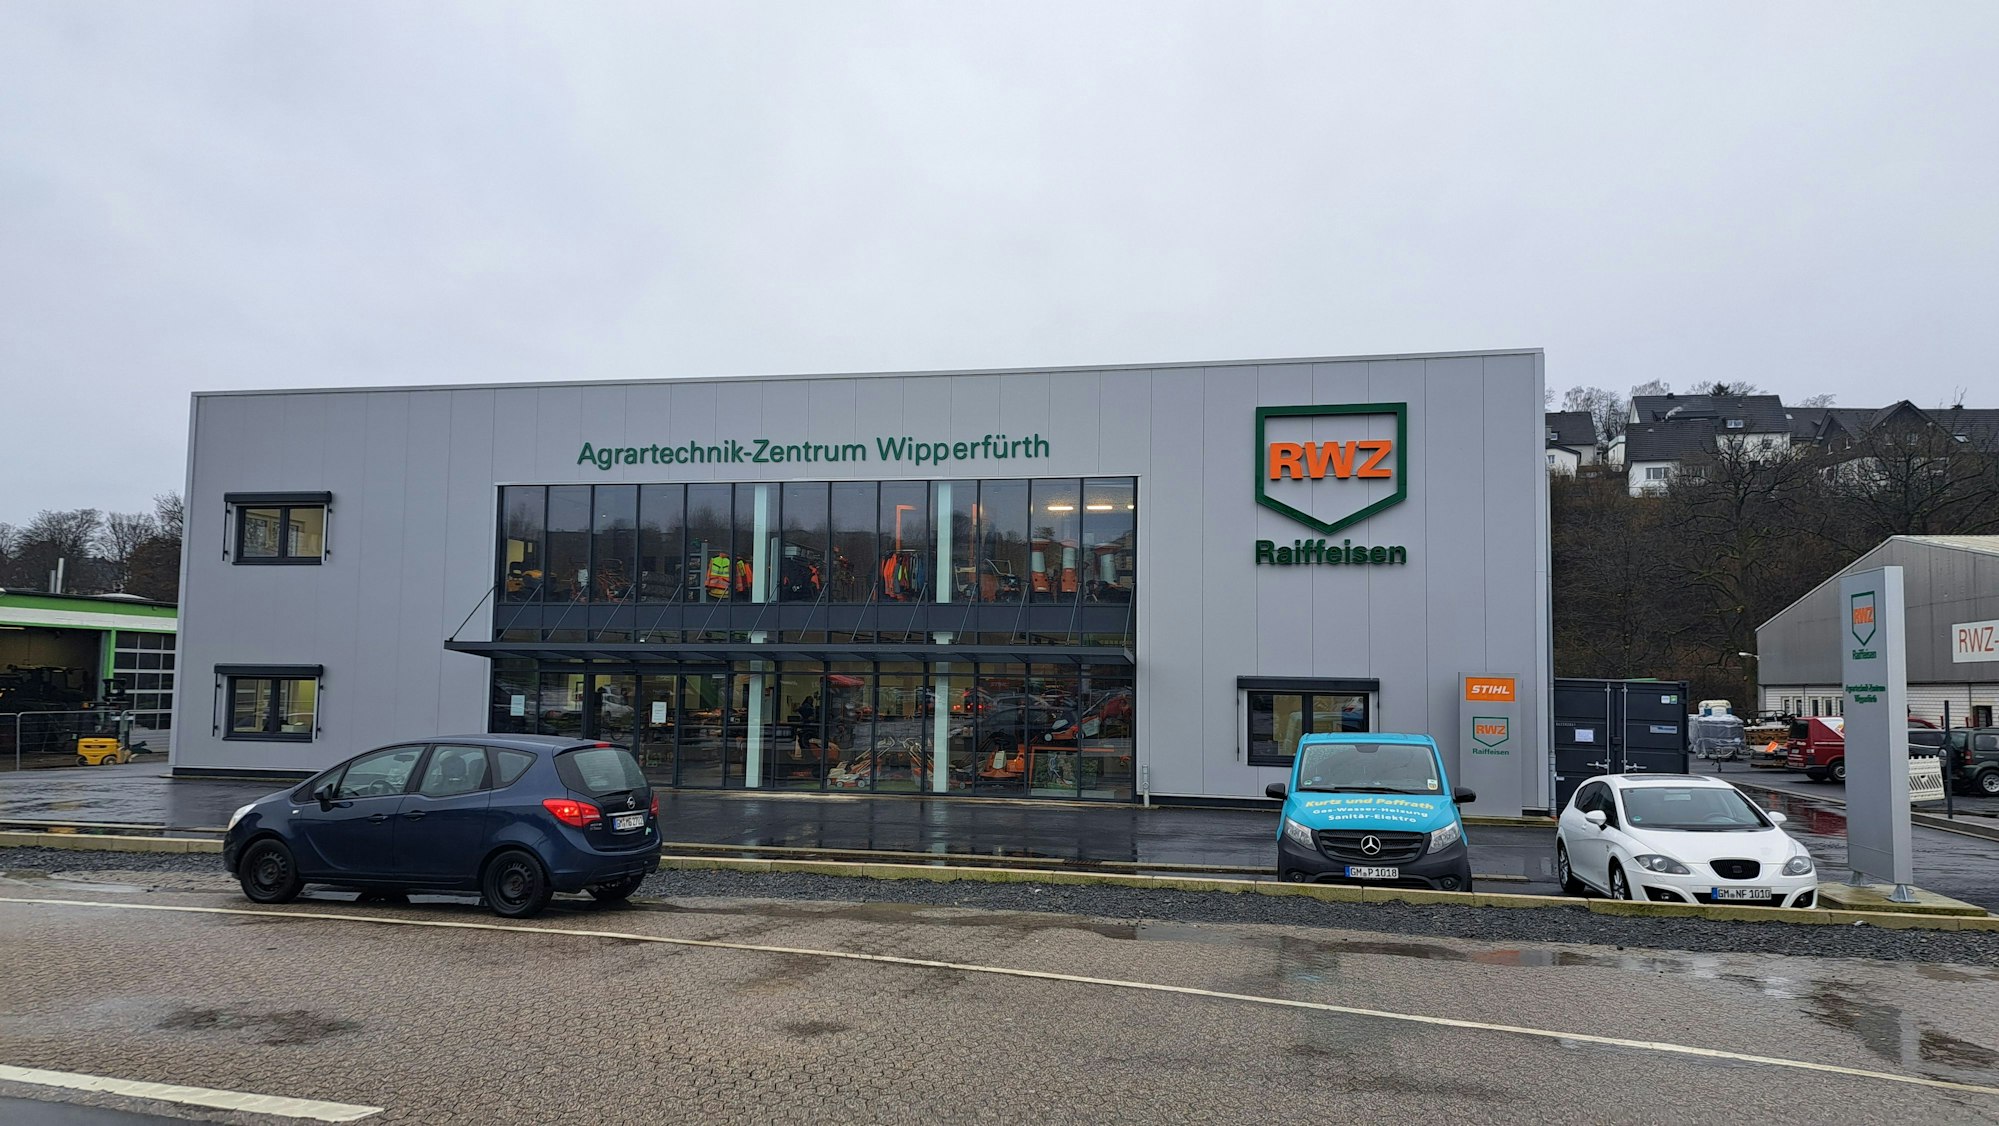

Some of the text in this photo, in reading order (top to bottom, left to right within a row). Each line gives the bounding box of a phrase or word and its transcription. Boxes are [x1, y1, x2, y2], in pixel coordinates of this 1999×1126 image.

[577, 433, 1050, 470] Agrartechnik-Zentrum Wipperfürth
[1269, 440, 1393, 481] RWZ
[1255, 539, 1408, 565] Raiffeisen
[1854, 607, 1874, 624] RWZ
[1471, 685, 1510, 694] STIHL
[1475, 724, 1506, 735] RWZ
[1375, 799, 1434, 810] Paffrath
[1312, 807, 1428, 818] Gas-Wasser-Heizung
[1328, 813, 1417, 823] Sanitär-Elektro
